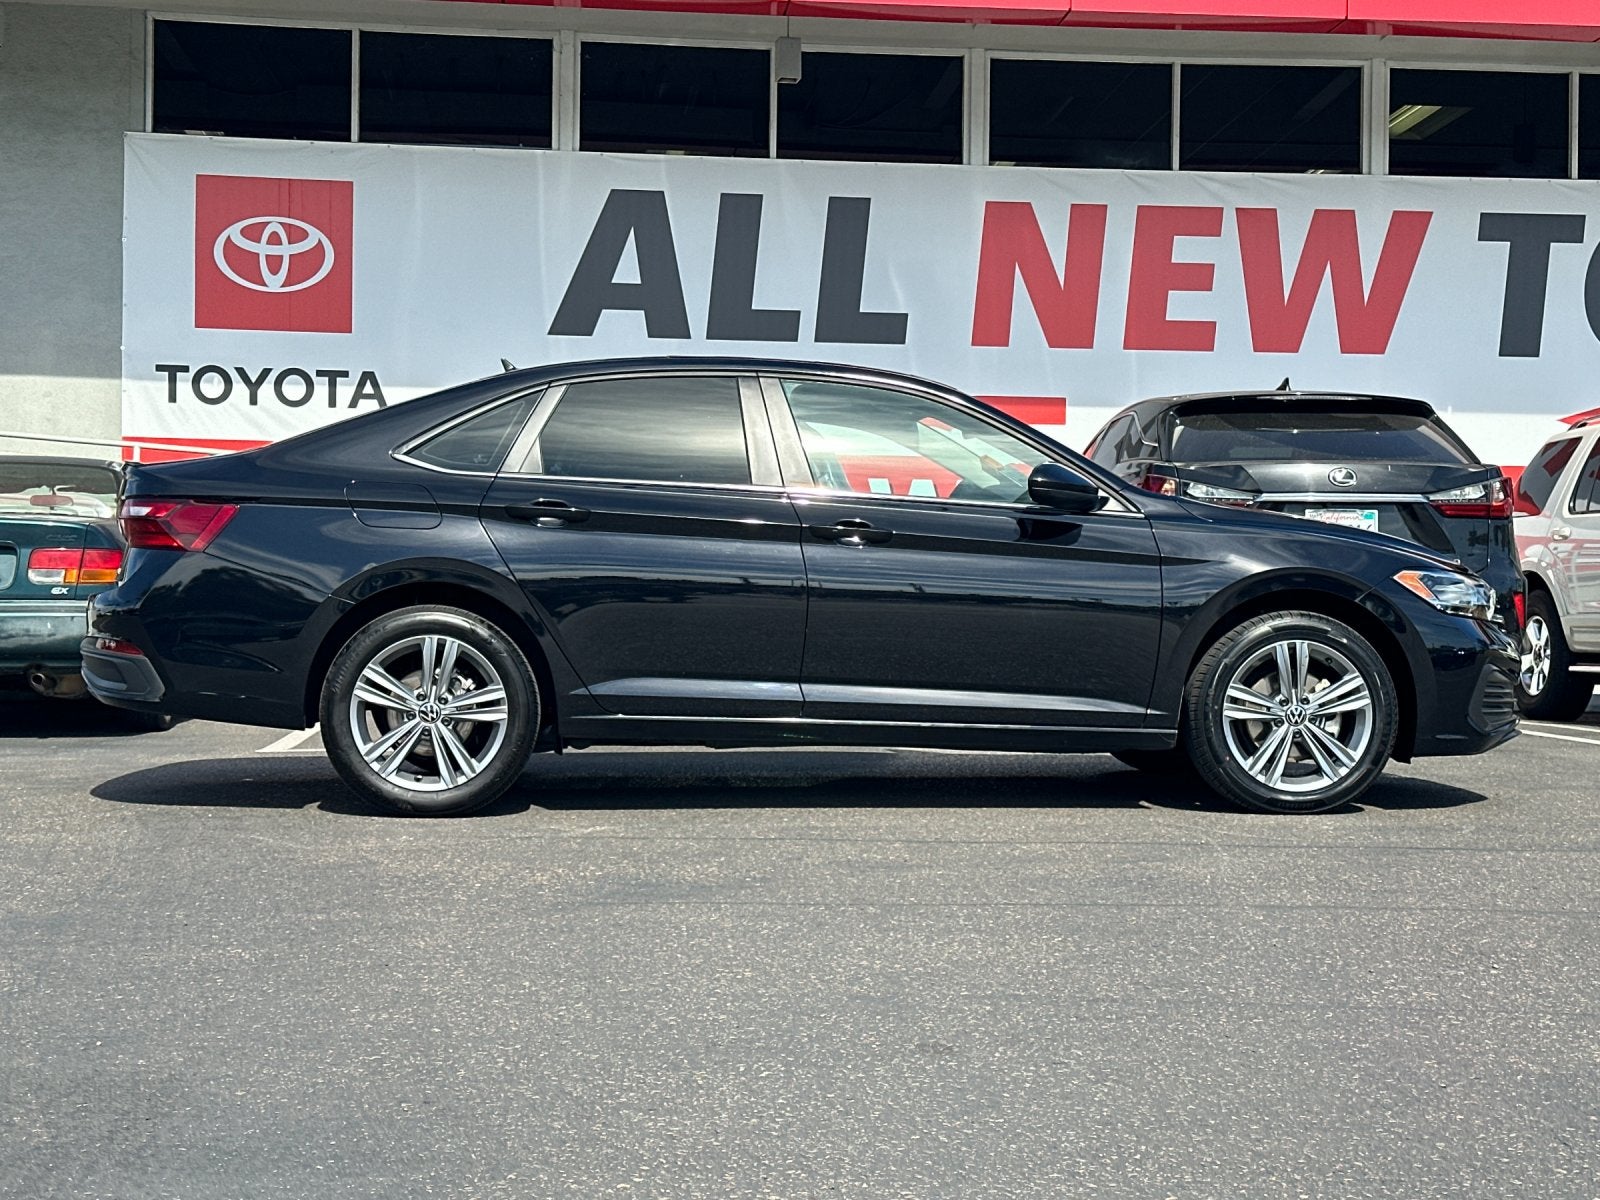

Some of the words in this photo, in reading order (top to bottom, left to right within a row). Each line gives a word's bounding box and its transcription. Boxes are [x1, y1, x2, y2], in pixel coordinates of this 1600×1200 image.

[548, 189, 908, 345] ALL
[971, 201, 1433, 354] NEW
[1478, 212, 1600, 357] T
[155, 364, 388, 409] TOYOTA
[51, 587, 69, 595] EX
